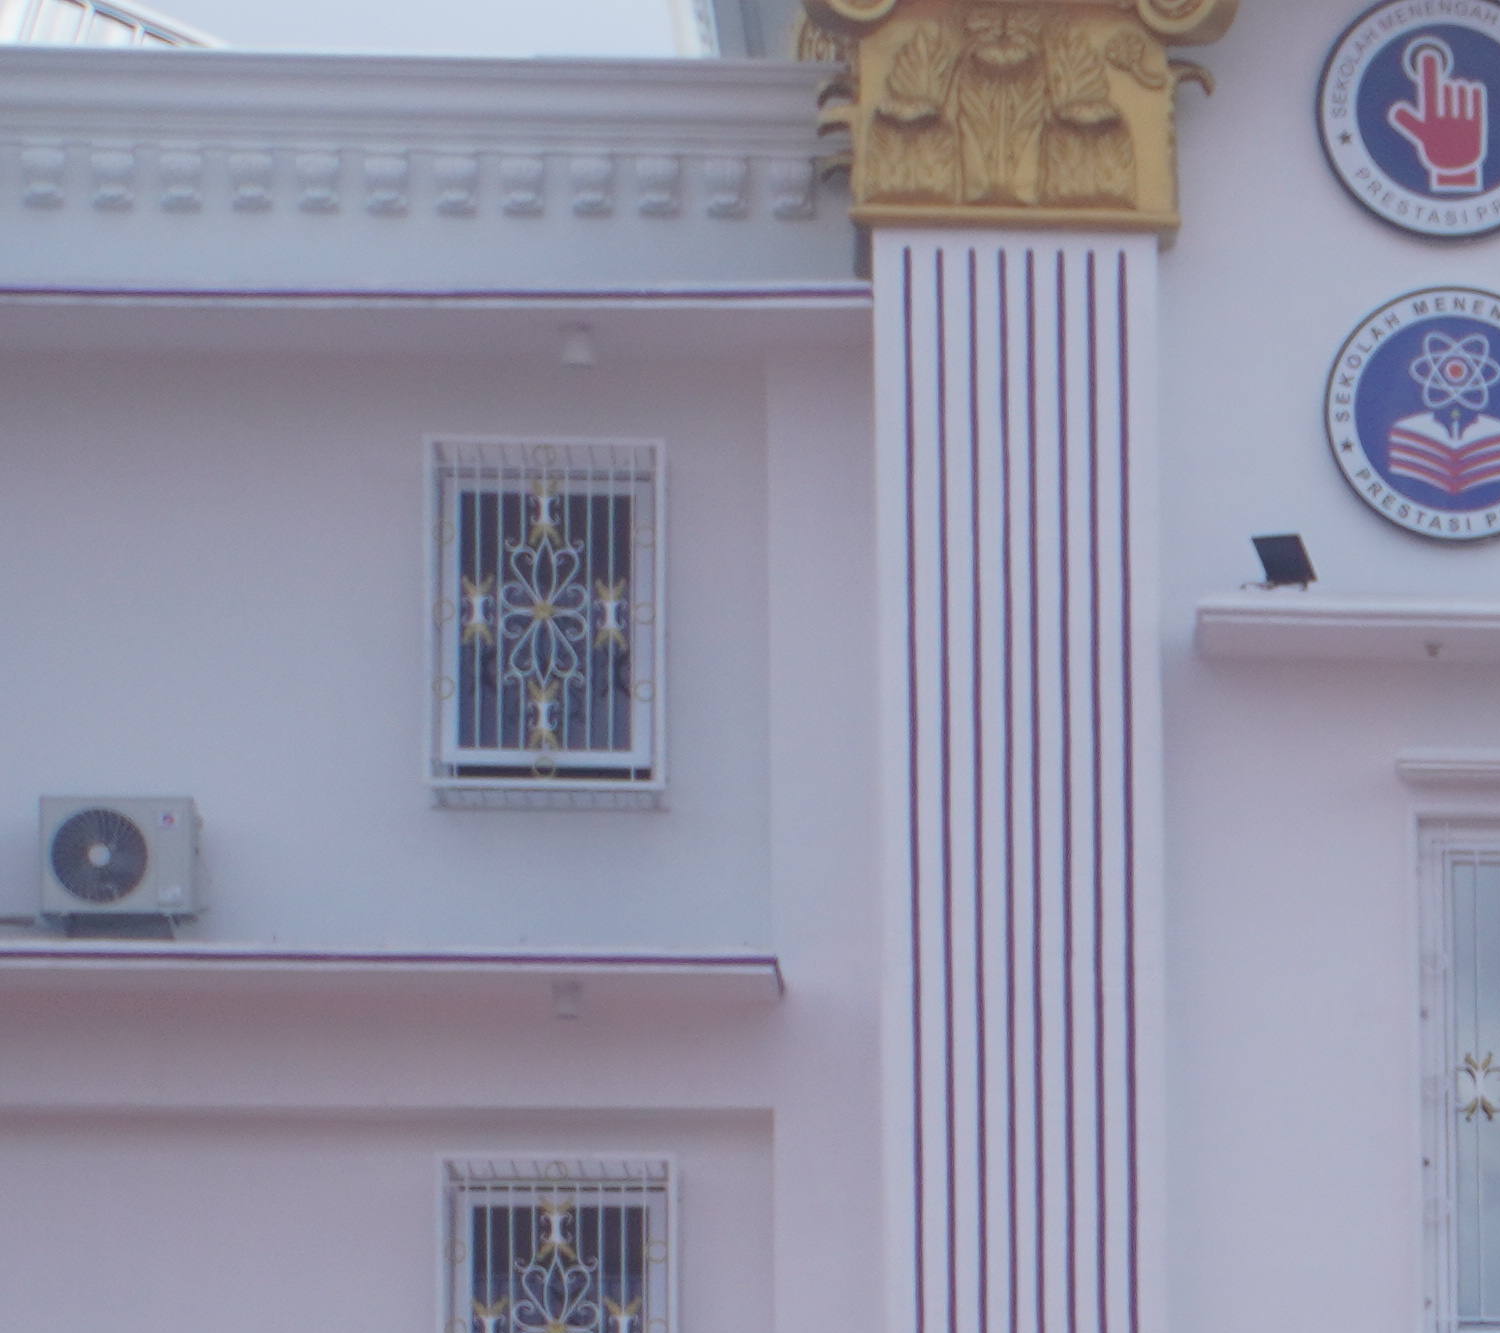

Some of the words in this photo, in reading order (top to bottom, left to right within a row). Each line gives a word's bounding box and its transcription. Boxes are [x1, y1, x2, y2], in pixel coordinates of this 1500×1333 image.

[1331, 31, 1378, 120] SEKOLAH
[1354, 167, 1469, 226] PRESTASI
[1336, 313, 1401, 423] SEKOLAH
[1355, 468, 1472, 532] PRESTASI
